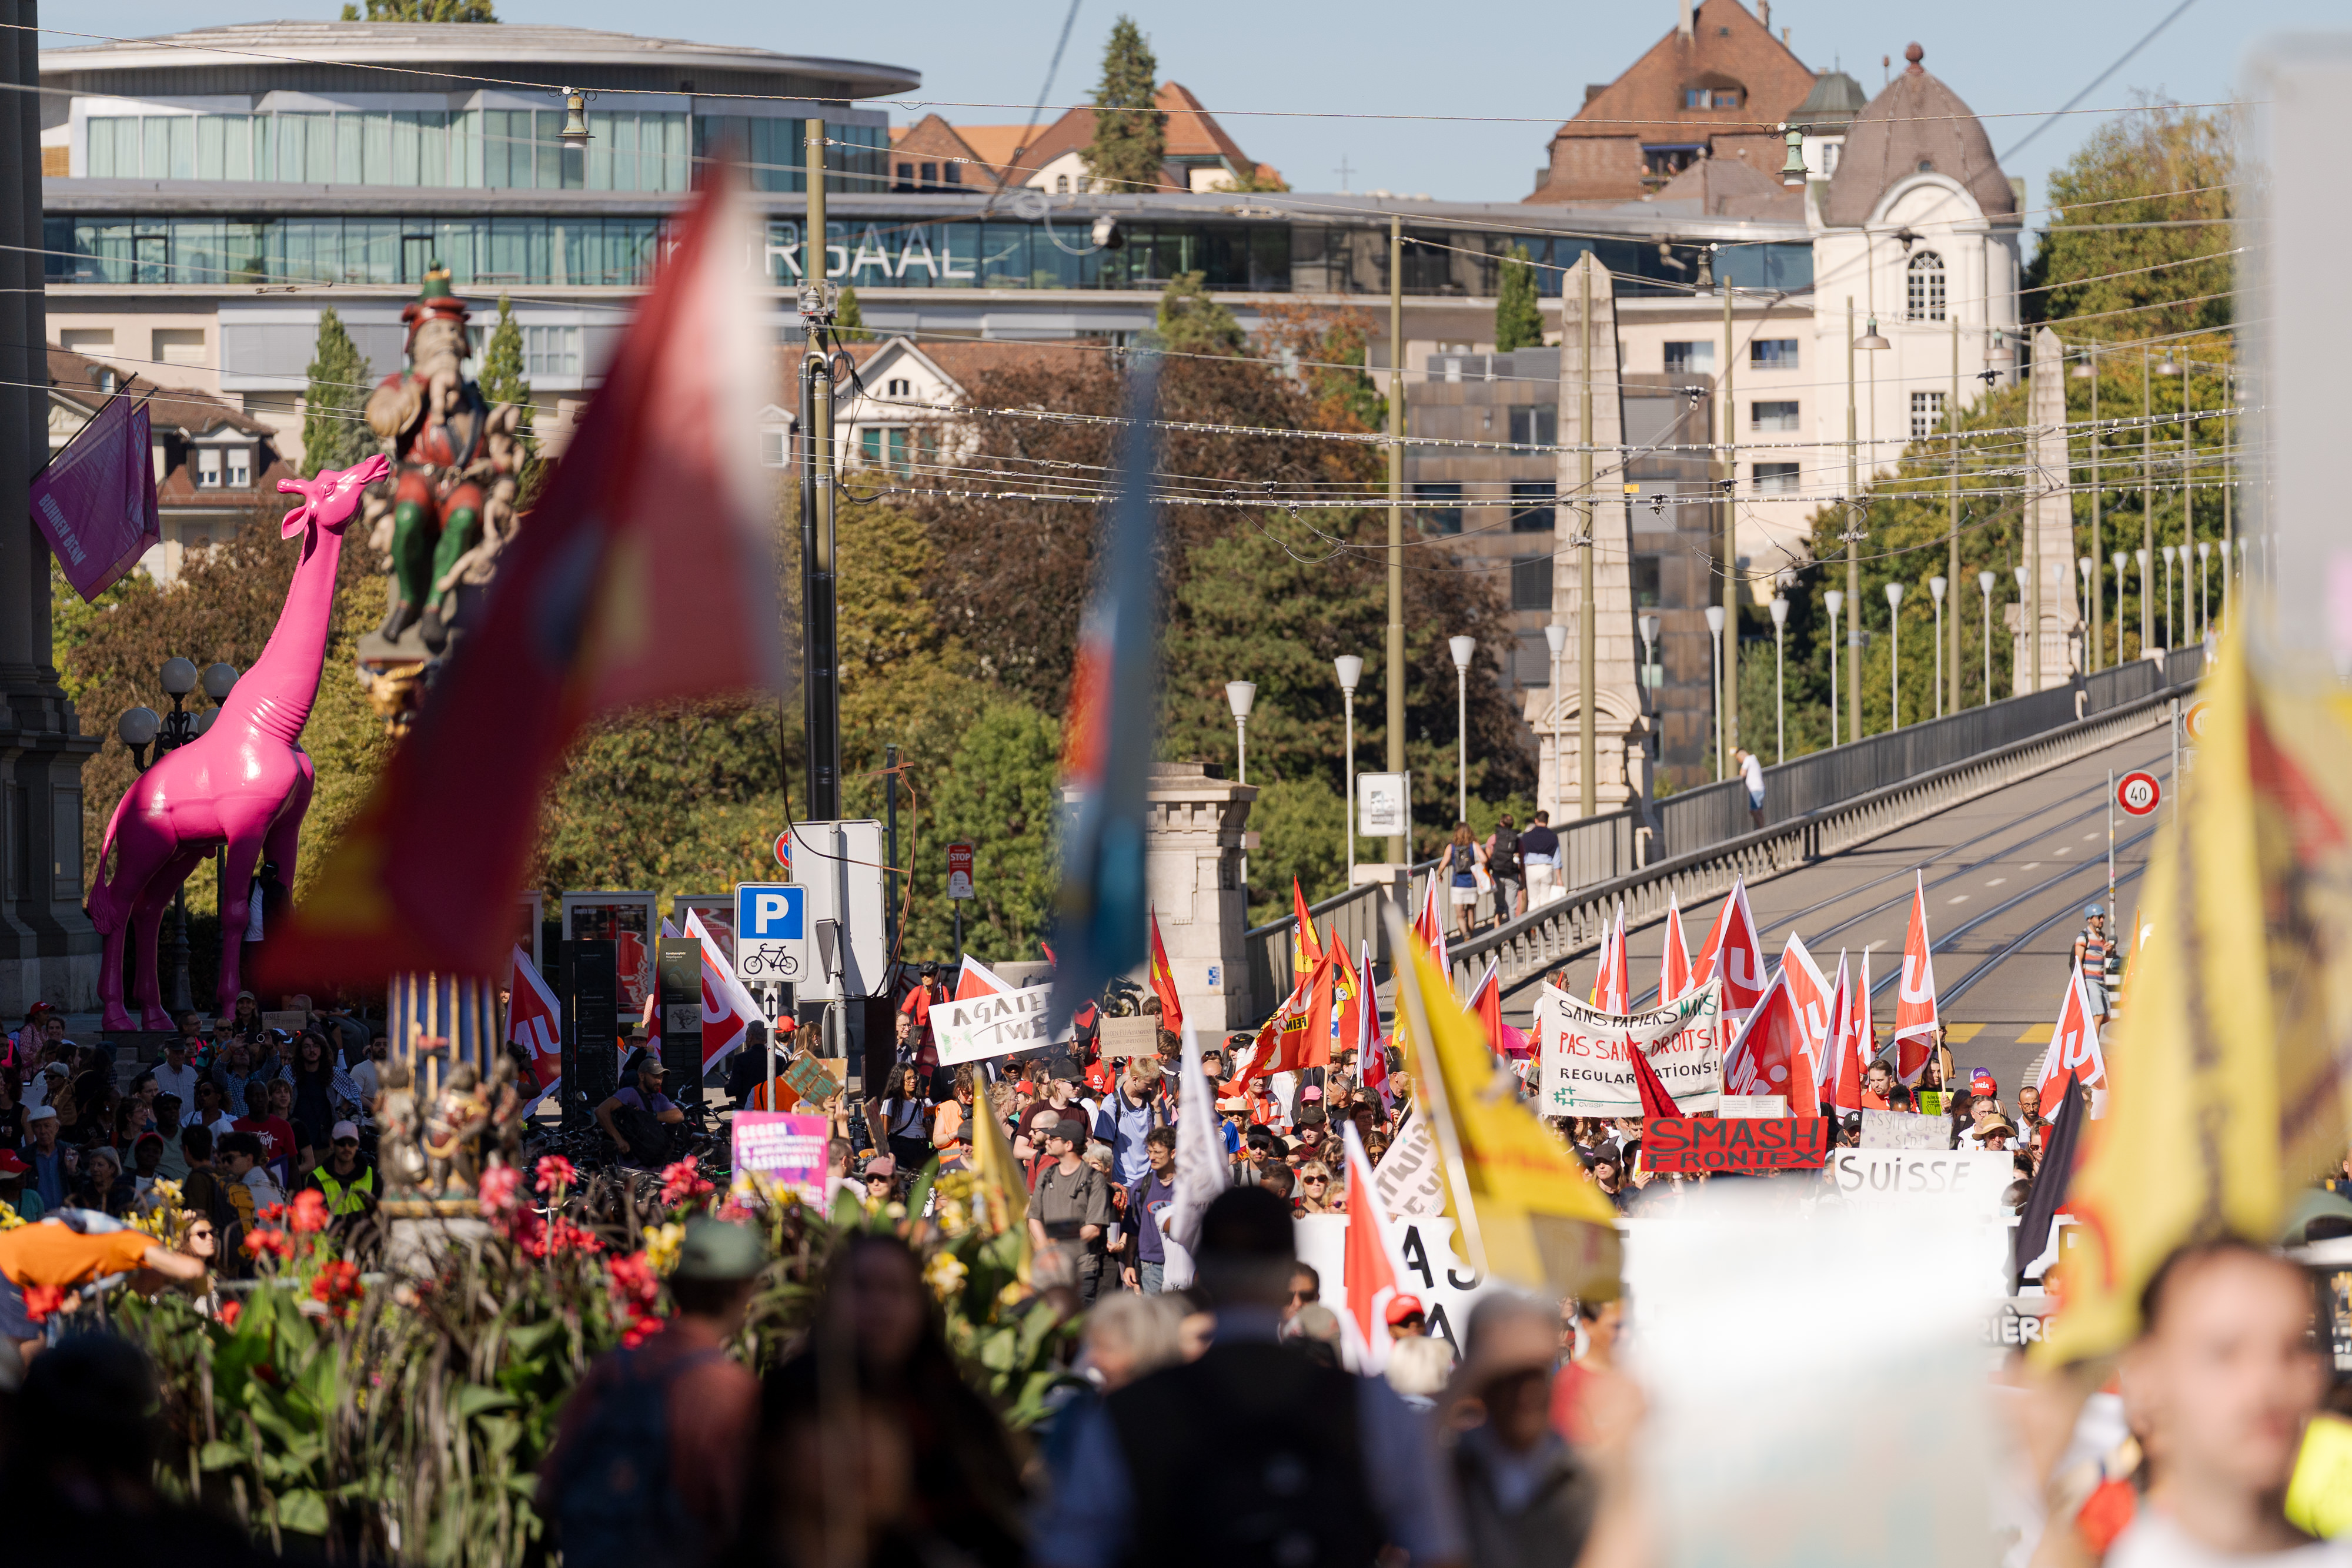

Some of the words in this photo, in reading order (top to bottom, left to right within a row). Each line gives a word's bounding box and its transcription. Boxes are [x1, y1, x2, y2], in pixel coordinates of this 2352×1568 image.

[742, 220, 975, 279] RSAAL
[62, 533, 86, 566] BERN
[2130, 787, 2147, 801] 40
[950, 852, 971, 861] STOP
[756, 894, 789, 934] P
[1559, 999, 1607, 1026] SANS
[1559, 1031, 1590, 1057] PAS
[737, 1122, 787, 1138] GEGEN
[1648, 1118, 1819, 1152] SMASH
[1647, 1149, 1822, 1169] FRONTEX
